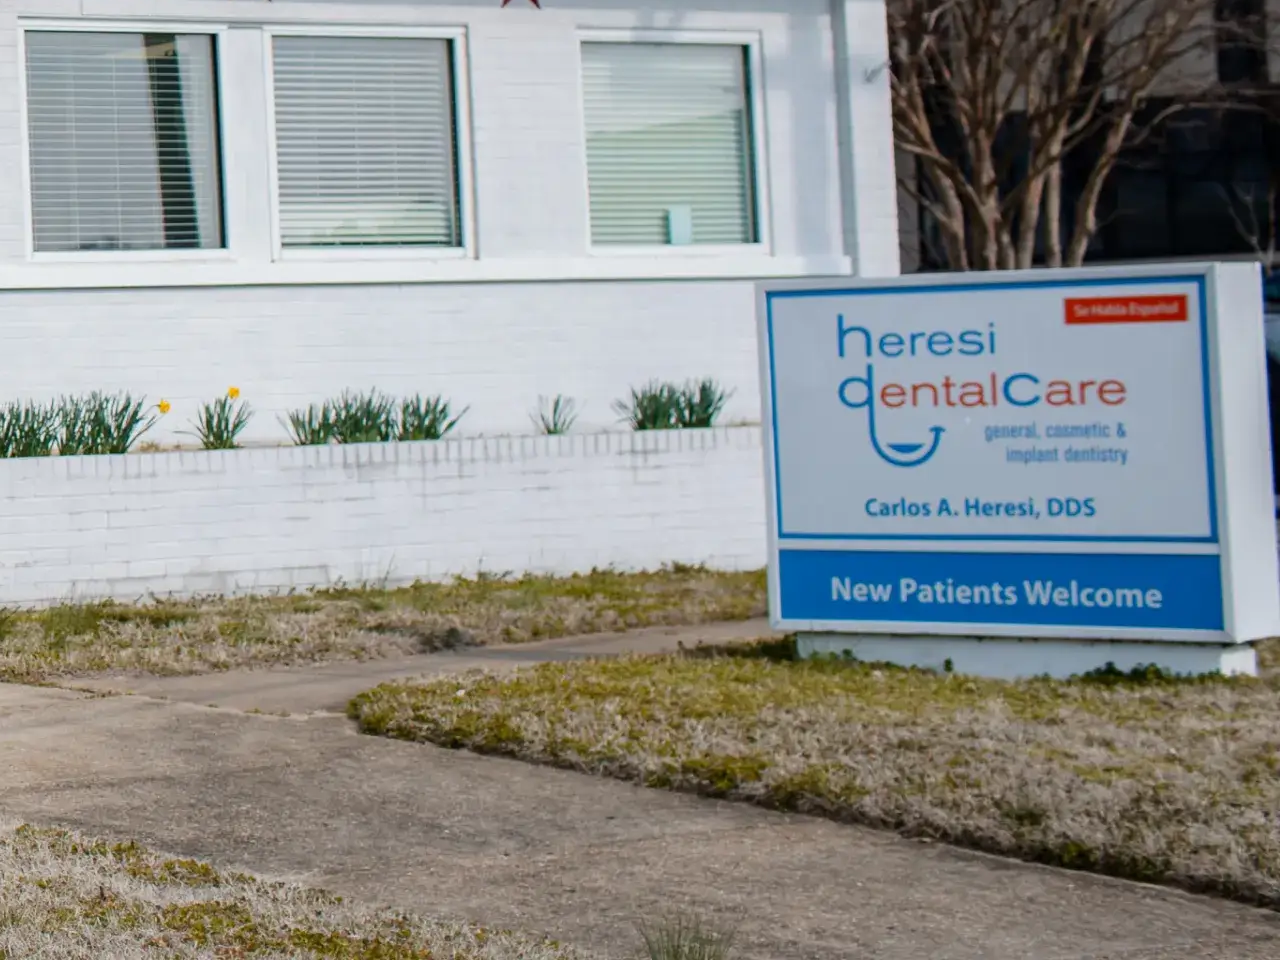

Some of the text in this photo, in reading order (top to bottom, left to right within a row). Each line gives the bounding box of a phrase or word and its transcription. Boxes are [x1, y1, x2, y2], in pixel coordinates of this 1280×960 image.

[837, 313, 996, 358] heresi
[838, 363, 1127, 408] dentalCare
[984, 421, 1127, 442] general, cosmetic &
[1006, 446, 1128, 465] implant dentistry
[865, 497, 1096, 520] Carlos A. Heresi, DDS
[830, 576, 1163, 609] New Patients Welcome
